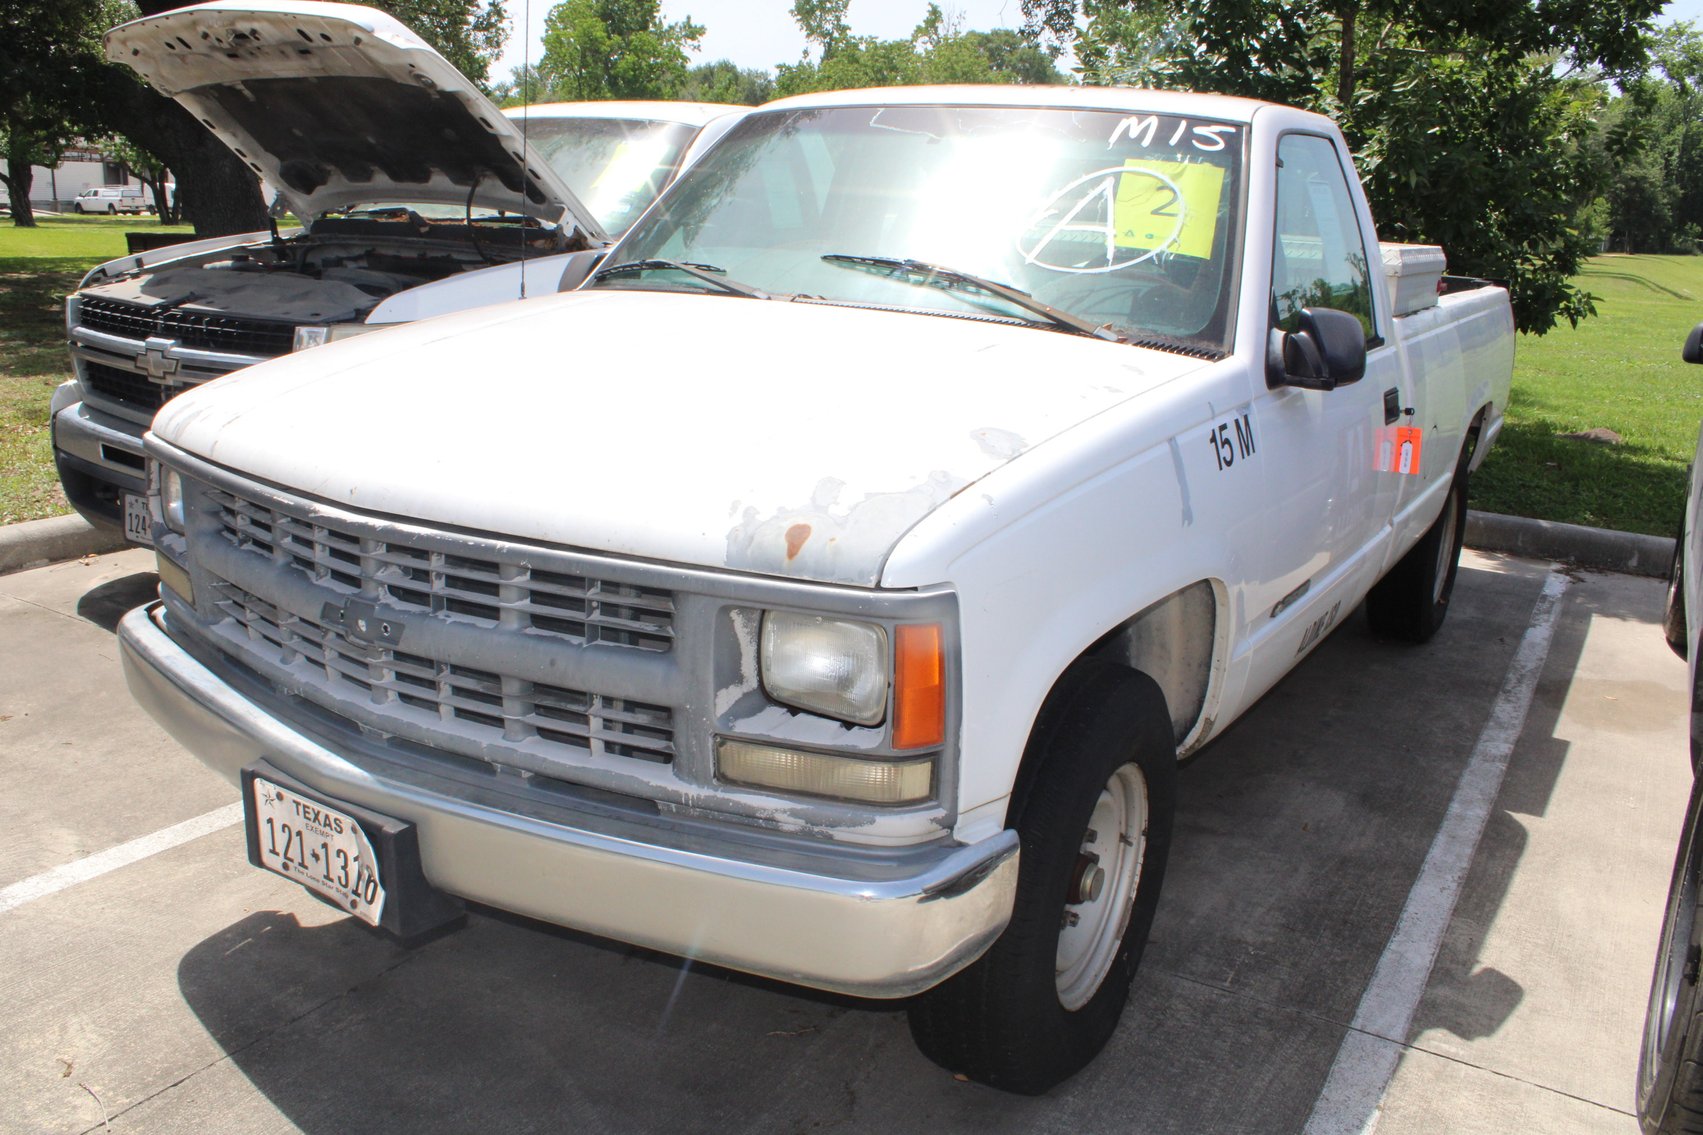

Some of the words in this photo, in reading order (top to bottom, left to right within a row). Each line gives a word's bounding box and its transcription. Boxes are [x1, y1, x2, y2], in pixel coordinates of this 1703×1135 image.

[1150, 185, 1180, 217] 2
[1209, 422, 1234, 471] 15
[1234, 413, 1256, 460] M
[292, 800, 344, 835] TEXAS
[305, 822, 334, 841] EXEMPT
[266, 817, 309, 870] 121
